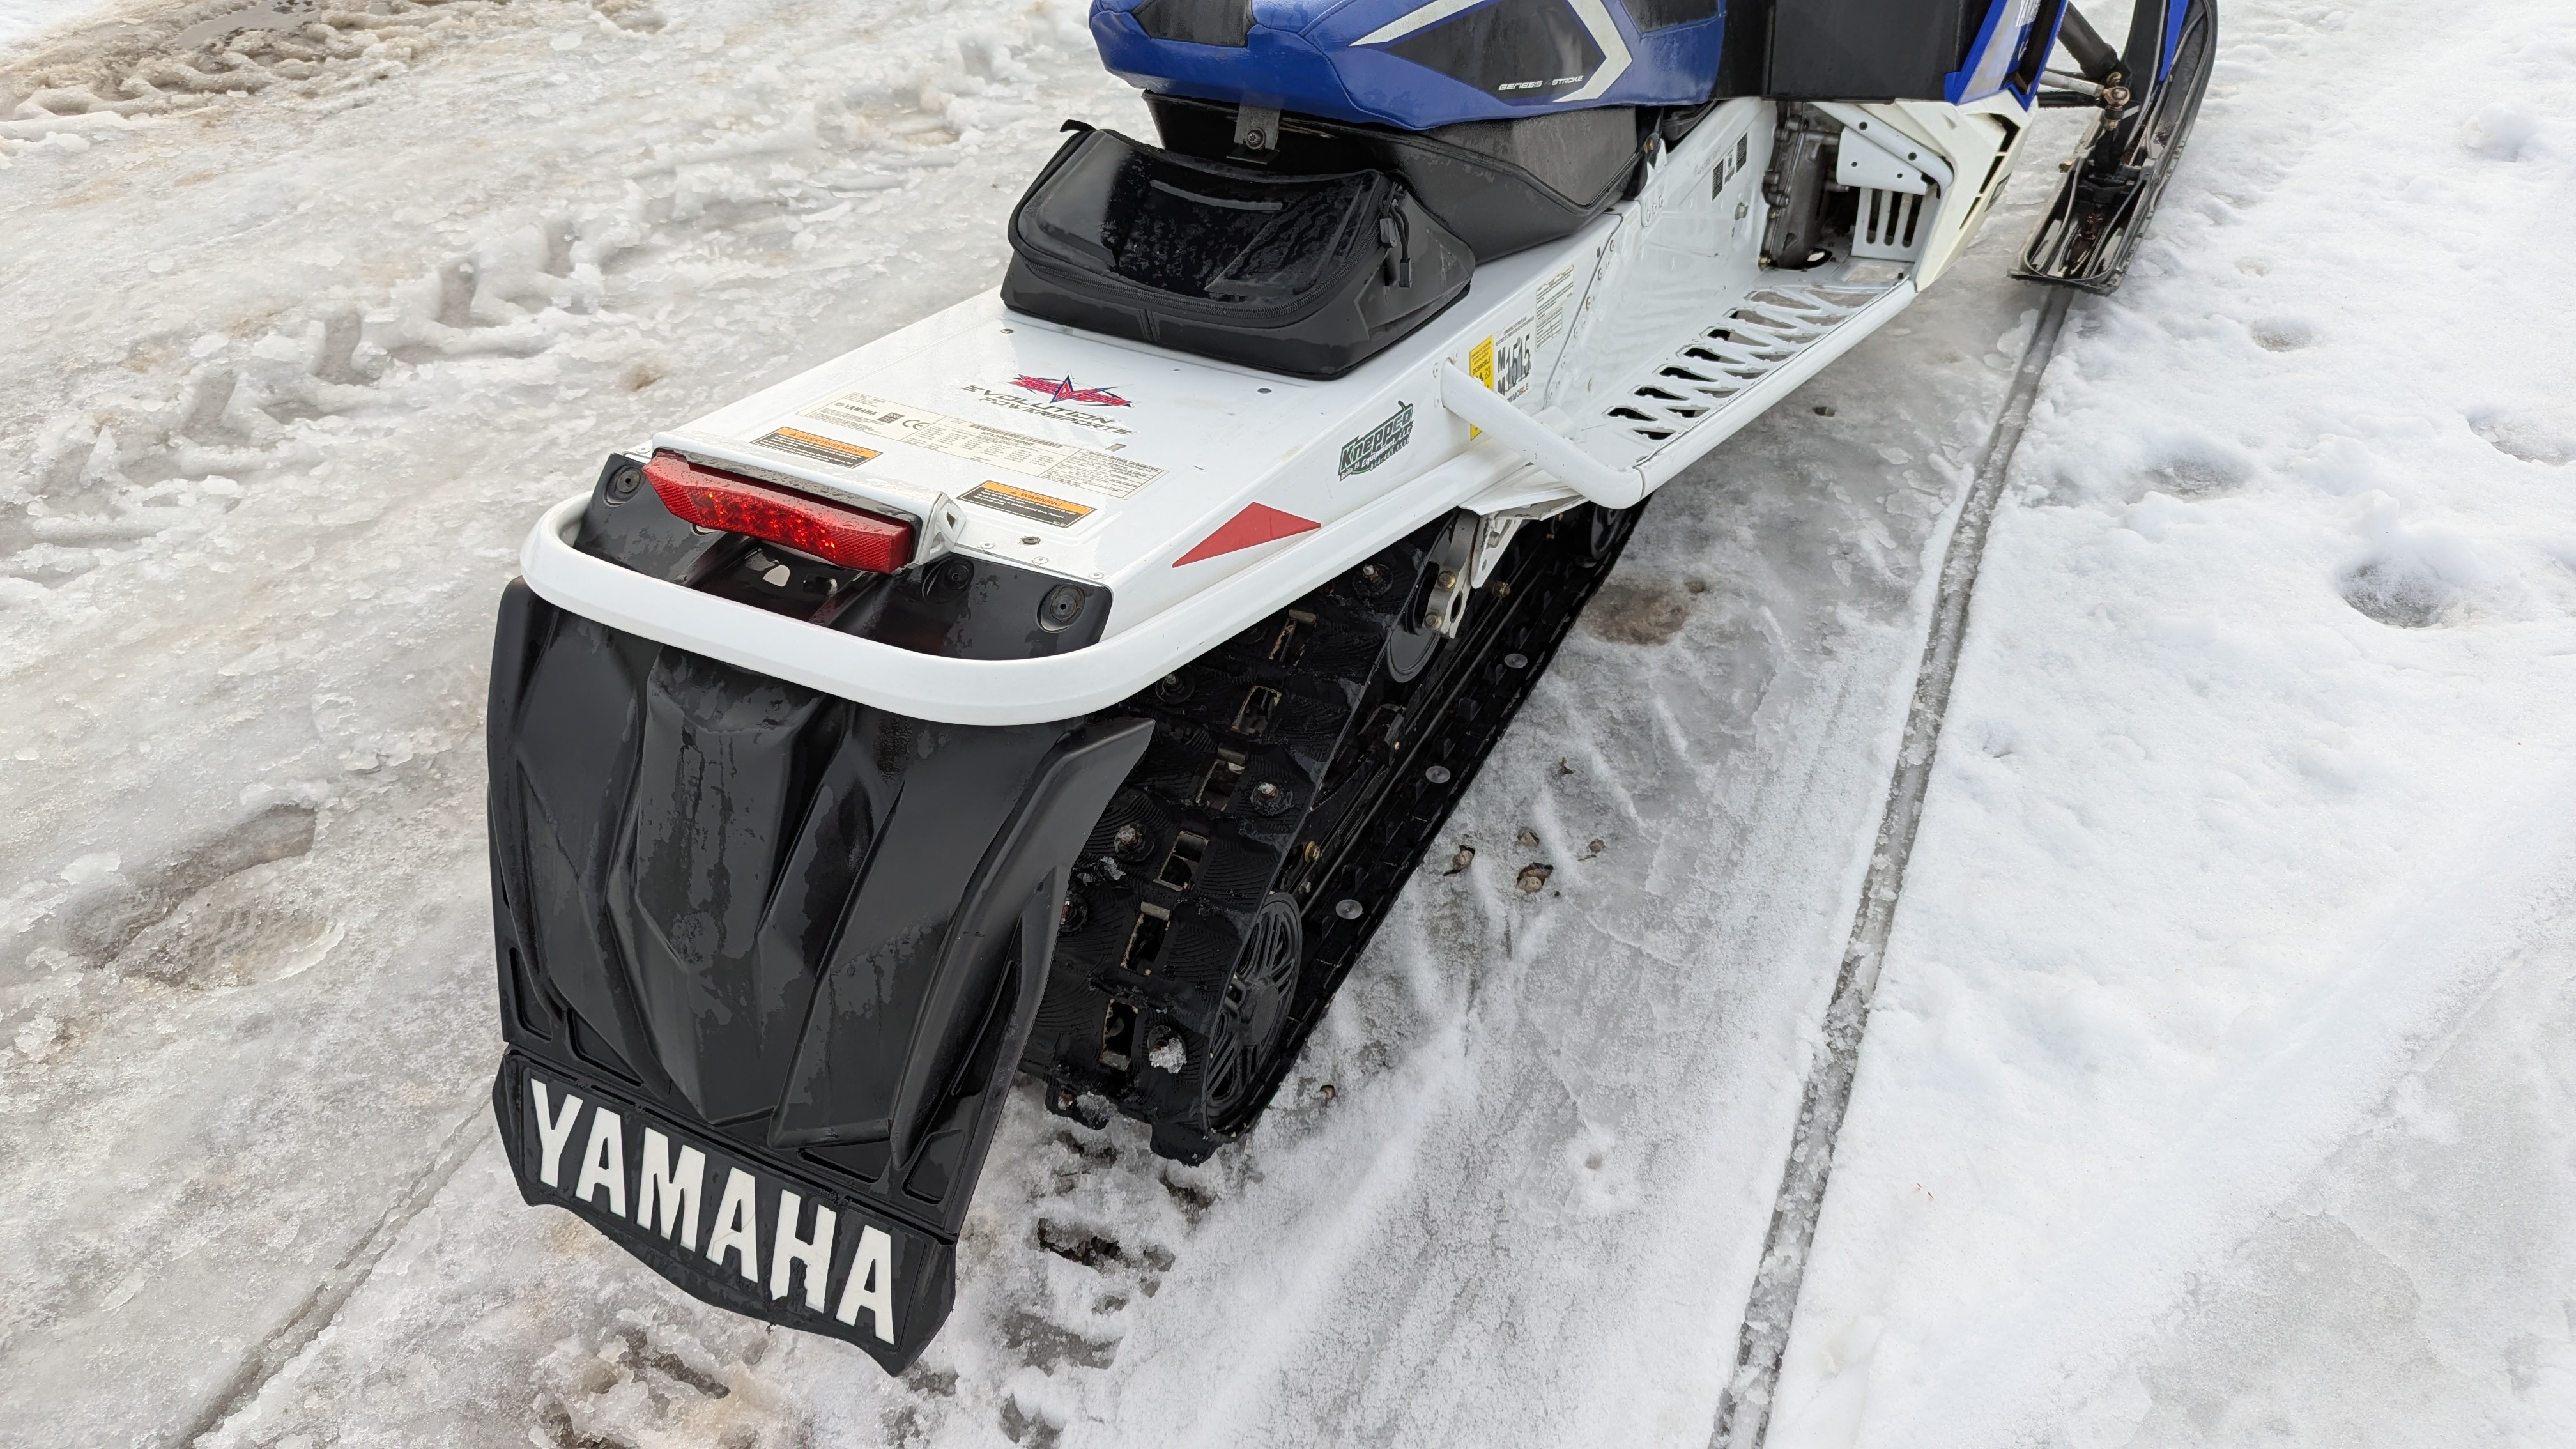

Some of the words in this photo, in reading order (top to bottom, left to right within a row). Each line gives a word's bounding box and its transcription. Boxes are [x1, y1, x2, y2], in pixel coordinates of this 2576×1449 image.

[1498, 80, 1543, 91] GENESIS
[1551, 75, 1584, 86] STROKE
[1484, 365, 1491, 380] 23
[843, 404, 878, 416] YAMAHA
[961, 384, 1117, 424] EVOLUTION
[979, 397, 1133, 434] POWERSPORTS
[901, 419, 930, 430] CE
[1399, 425, 1411, 441] LLC
[799, 434, 866, 454] AVERTISSEMENT
[1020, 493, 1062, 507] WARNING
[531, 1078, 894, 1345] YAMAHA
